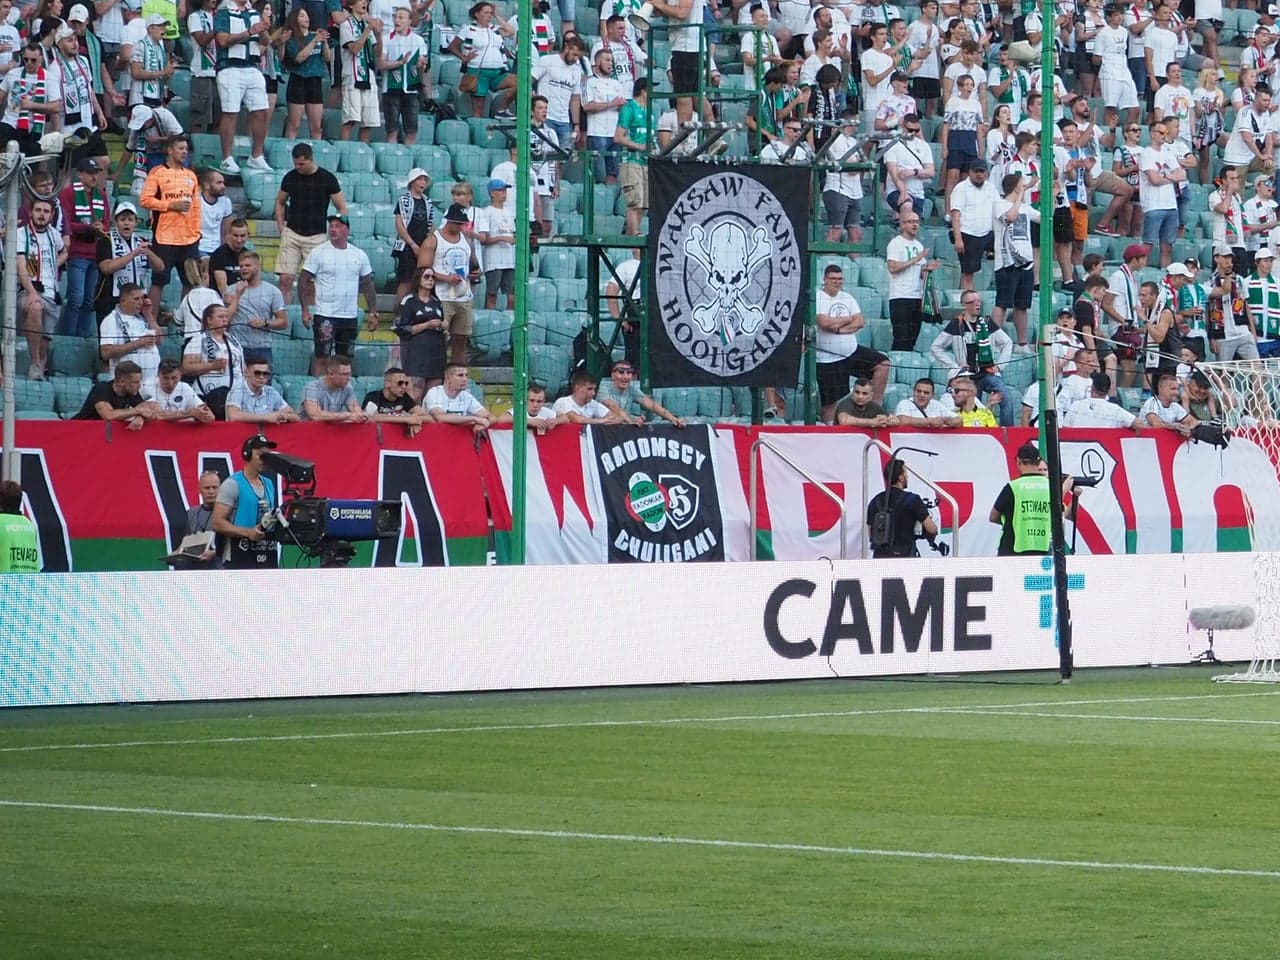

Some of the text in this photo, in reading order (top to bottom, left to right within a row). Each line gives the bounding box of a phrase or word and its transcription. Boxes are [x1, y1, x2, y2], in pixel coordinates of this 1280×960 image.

[659, 176, 743, 275] WARSAW
[755, 192, 797, 277] FANS
[663, 297, 792, 372] HOOLIGANS
[601, 437, 706, 474] RADOMSCY
[614, 527, 717, 563] CHULIGANI
[764, 576, 993, 659] CAME
